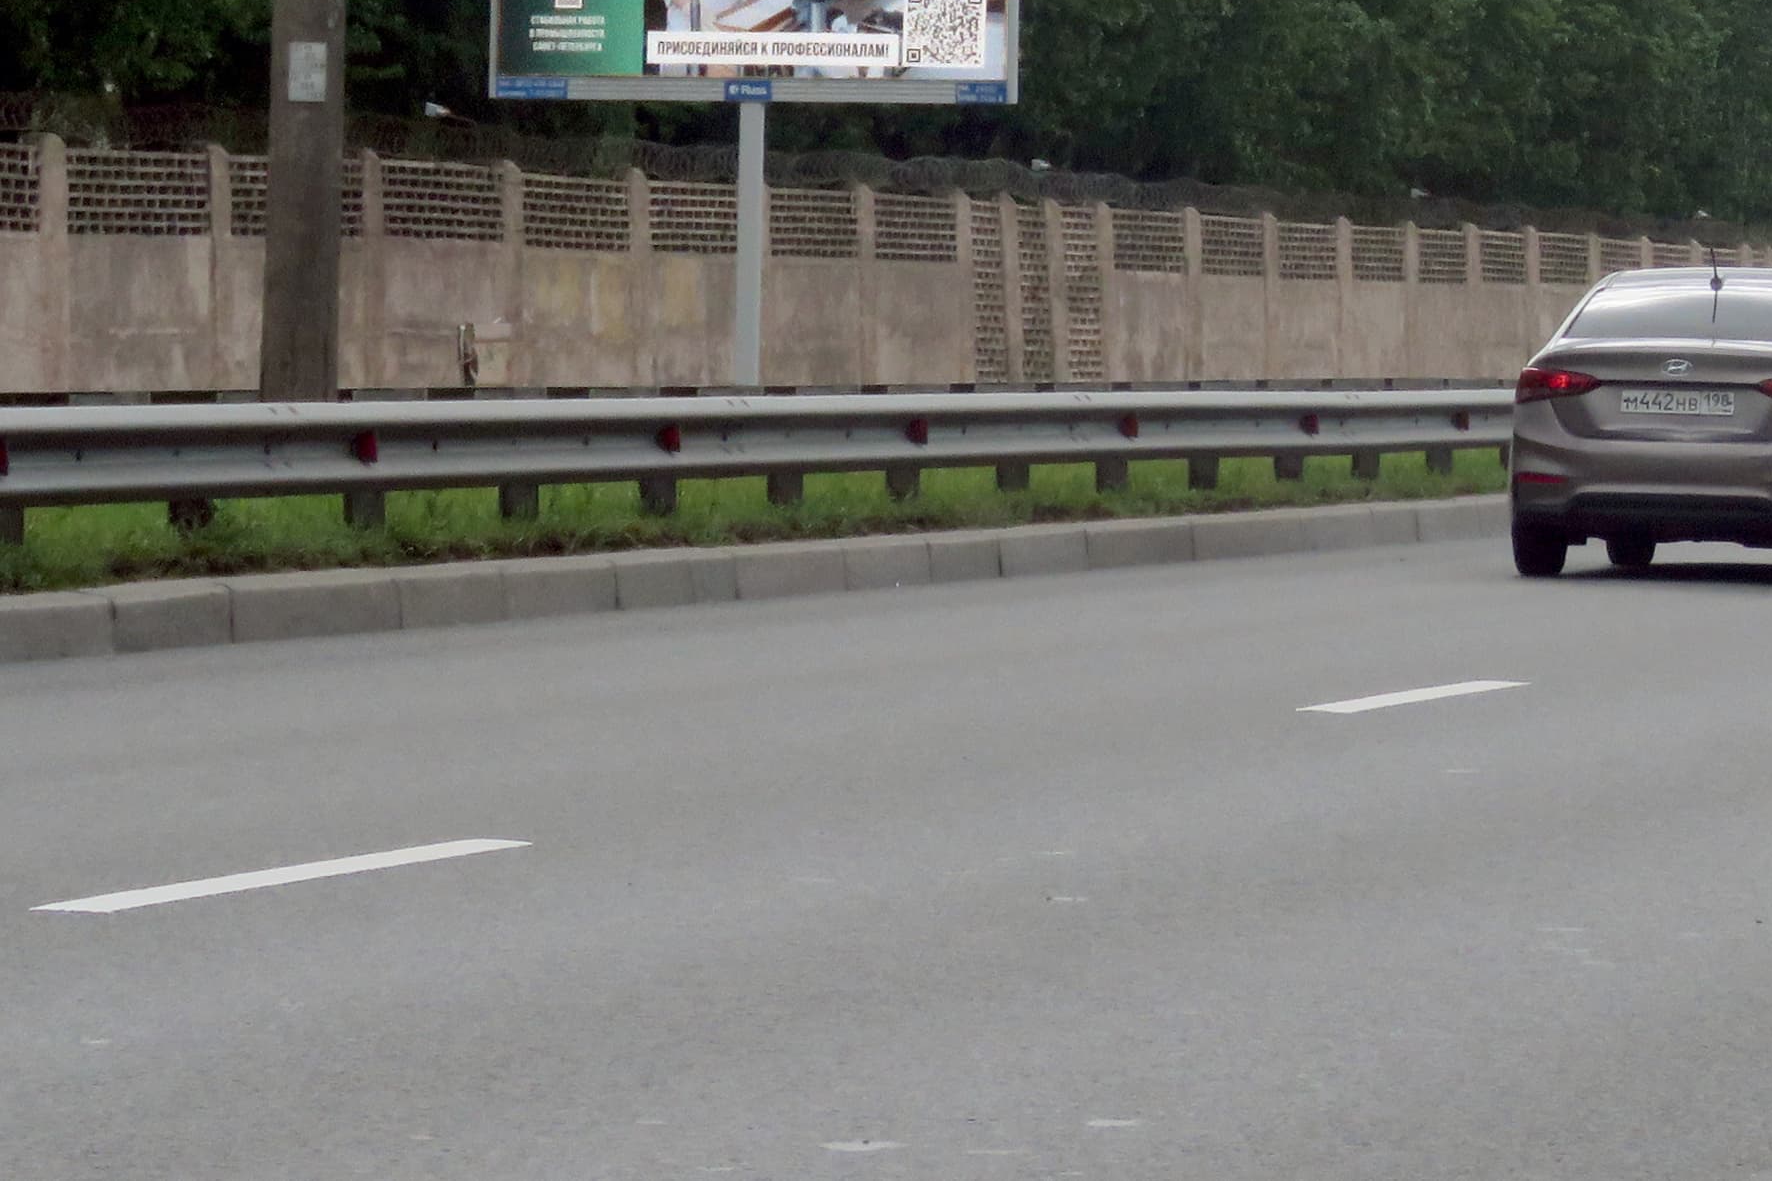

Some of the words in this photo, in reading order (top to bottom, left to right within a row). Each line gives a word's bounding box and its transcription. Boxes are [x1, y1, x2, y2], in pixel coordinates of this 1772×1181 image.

[657, 39, 758, 57] ПРИСОЕДИНЯЙСЯ
[760, 41, 768, 56] К
[771, 41, 889, 58] ПРОФЕССИОНАЛАМ!
